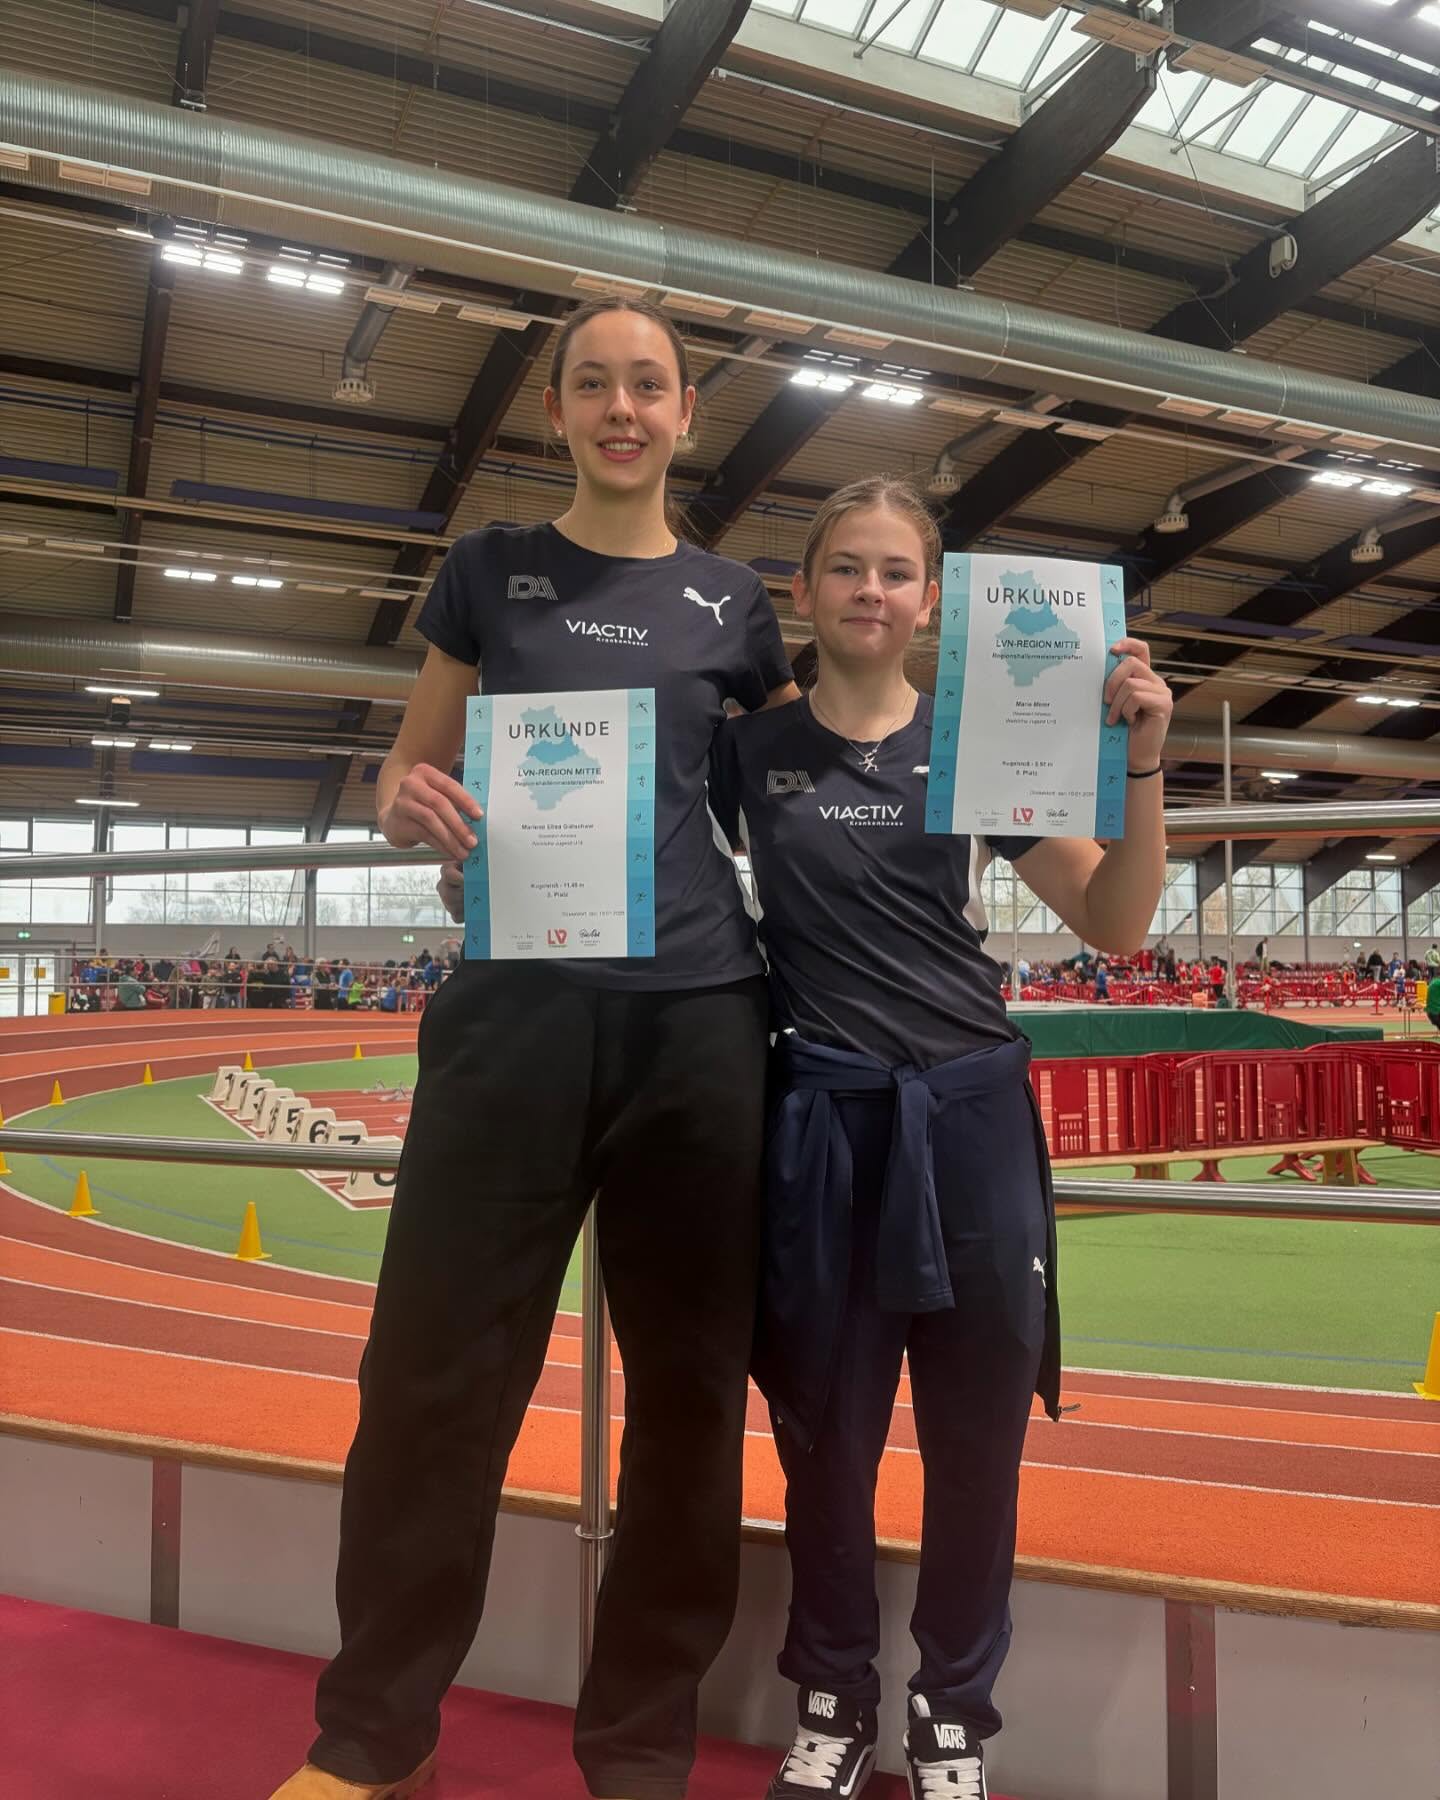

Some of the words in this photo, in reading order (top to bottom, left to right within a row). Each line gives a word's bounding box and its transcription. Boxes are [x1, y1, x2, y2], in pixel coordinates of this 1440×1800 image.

[987, 587, 1086, 607] URKUNDE
[566, 619, 648, 640] VIACTIV
[996, 640, 1052, 648] LVN-REGION
[1053, 641, 1080, 649] MITTE
[508, 721, 609, 739] URKUNDE
[518, 768, 573, 776] LVN-REGION
[575, 767, 602, 775] MITTE
[819, 805, 903, 820] VIACTIV
[286, 1107, 304, 1135] 5
[309, 1120, 329, 1143] 6
[808, 1690, 838, 1719] VANS
[933, 1724, 967, 1750] VANS
